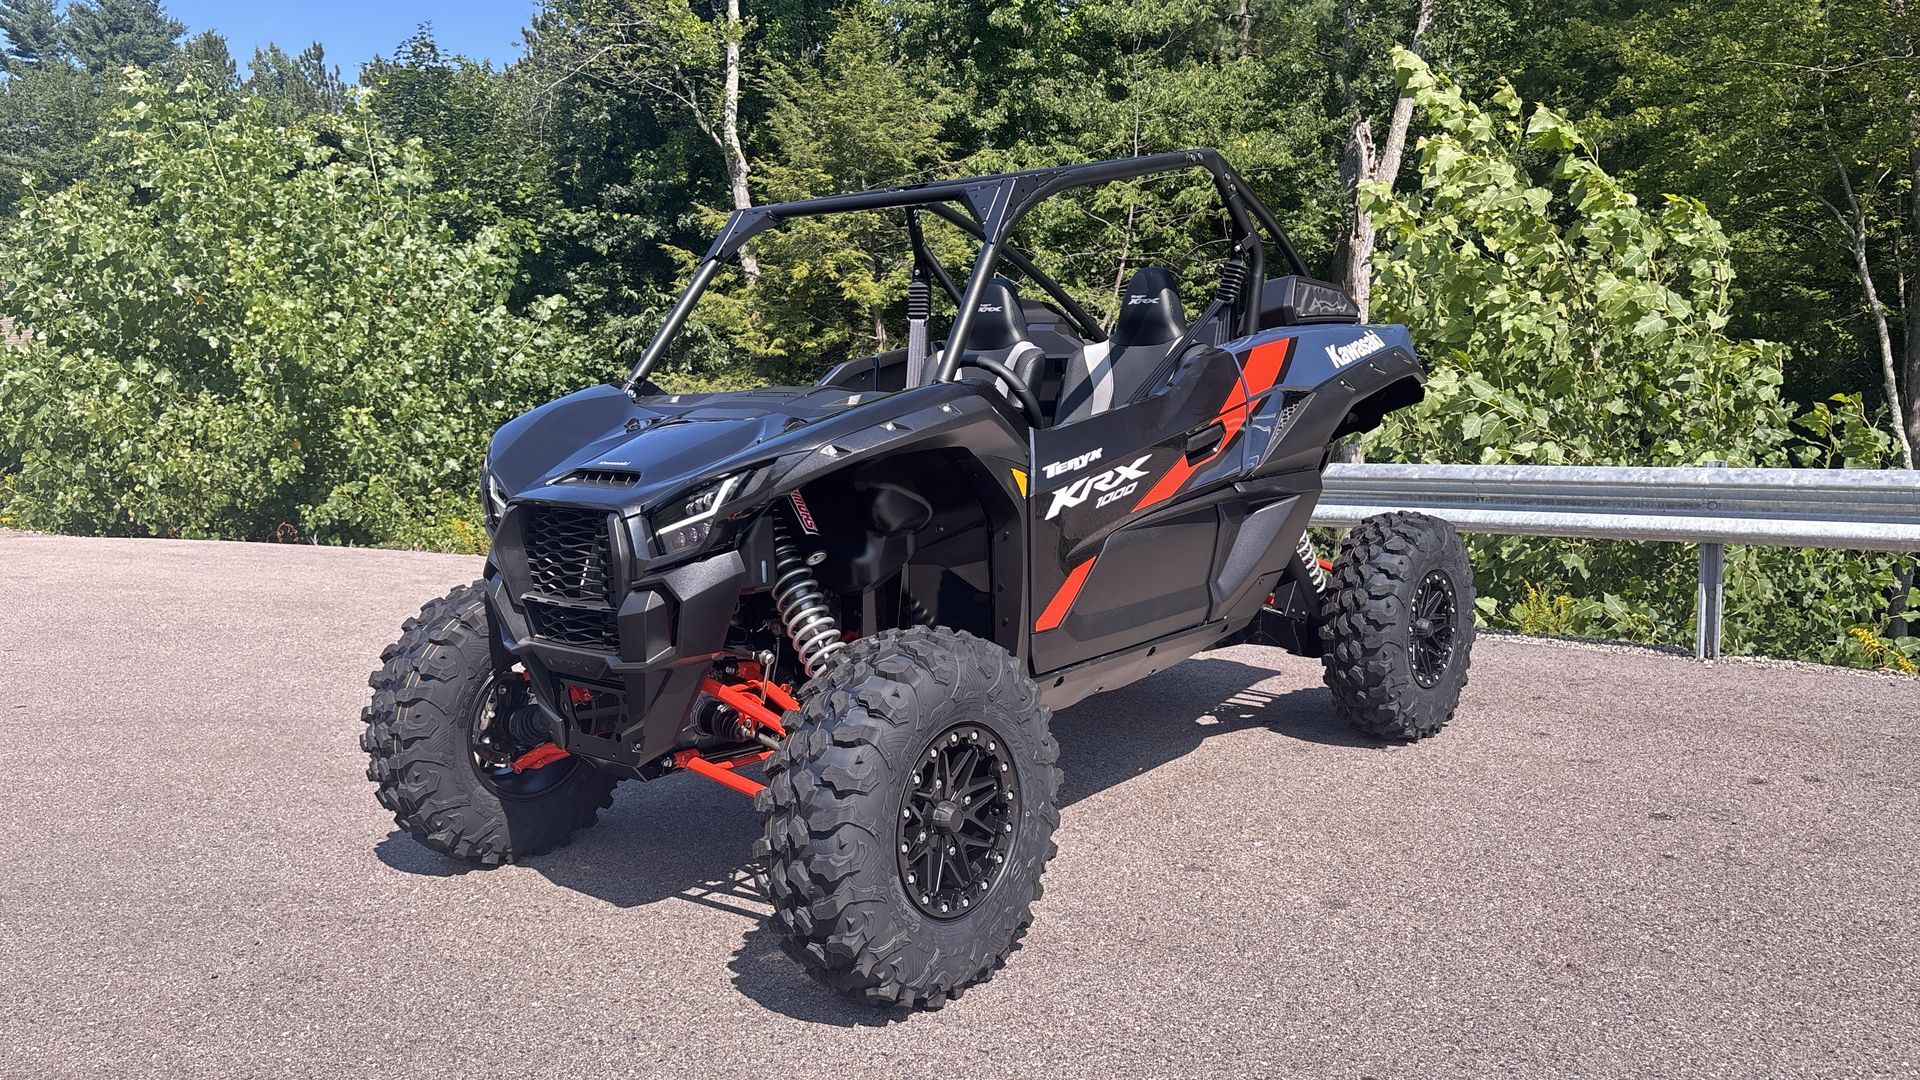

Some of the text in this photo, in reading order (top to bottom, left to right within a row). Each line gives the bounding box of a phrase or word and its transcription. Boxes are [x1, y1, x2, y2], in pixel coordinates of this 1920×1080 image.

[1324, 329, 1386, 369] Kawasaki
[1044, 453, 1153, 521] KRX
[1094, 481, 1139, 509] 1000
